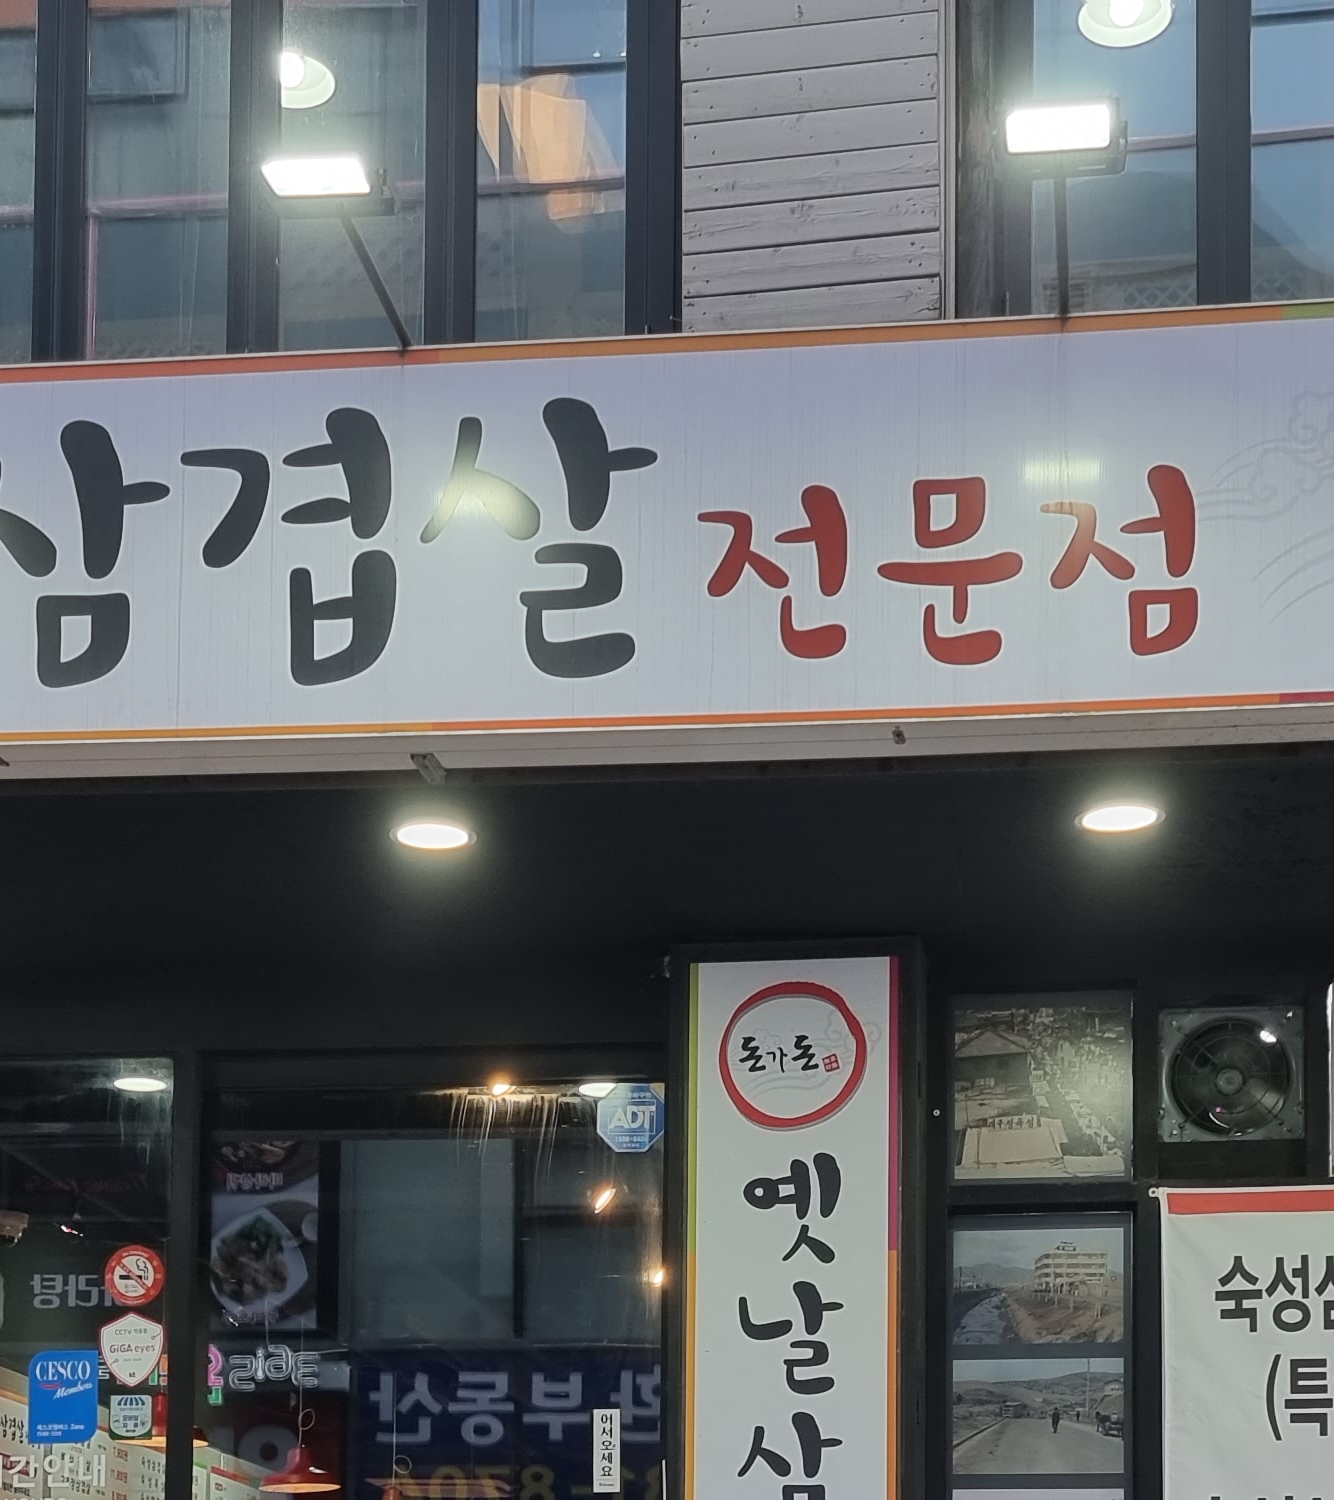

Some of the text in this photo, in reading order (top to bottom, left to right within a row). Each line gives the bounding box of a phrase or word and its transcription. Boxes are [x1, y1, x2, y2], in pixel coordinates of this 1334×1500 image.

[697, 464, 1199, 665] 전문점
[738, 1035, 818, 1073] 돈가돈
[609, 1105, 655, 1129] ADT
[134, 1344, 156, 1354] eyes
[35, 1361, 90, 1381] CESCO
[53, 1381, 93, 1399] Members
[600, 1413, 613, 1476] 어서오세요
